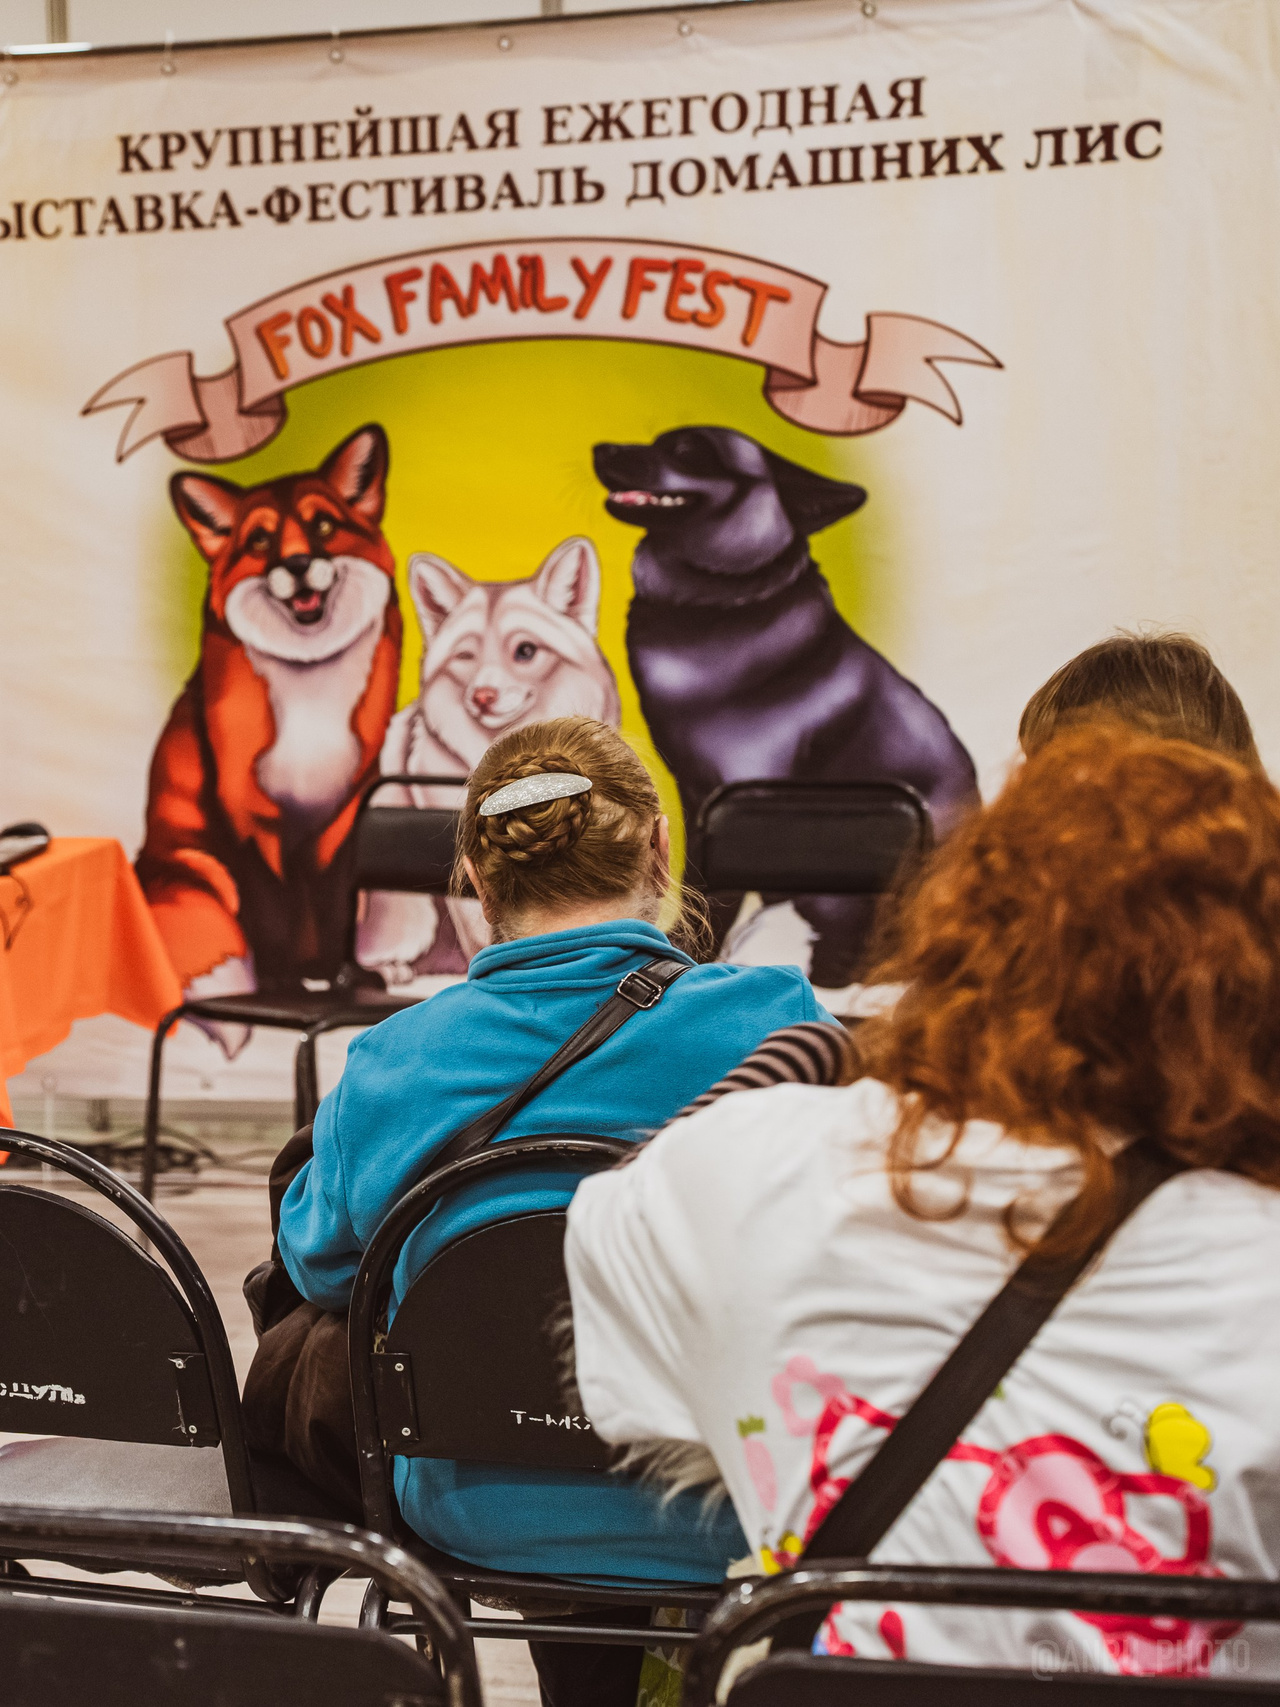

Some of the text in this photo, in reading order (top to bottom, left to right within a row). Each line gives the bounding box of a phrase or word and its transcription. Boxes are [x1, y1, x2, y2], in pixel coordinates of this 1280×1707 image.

[118, 76, 927, 174] КРУПНЕЙШАЯ ЕЖЕГОДНАЯ
[625, 131, 1005, 207] ДОМАШНИХ
[1024, 118, 1163, 170] ЛИС
[255, 253, 792, 381] FOX FAMILY FEST
